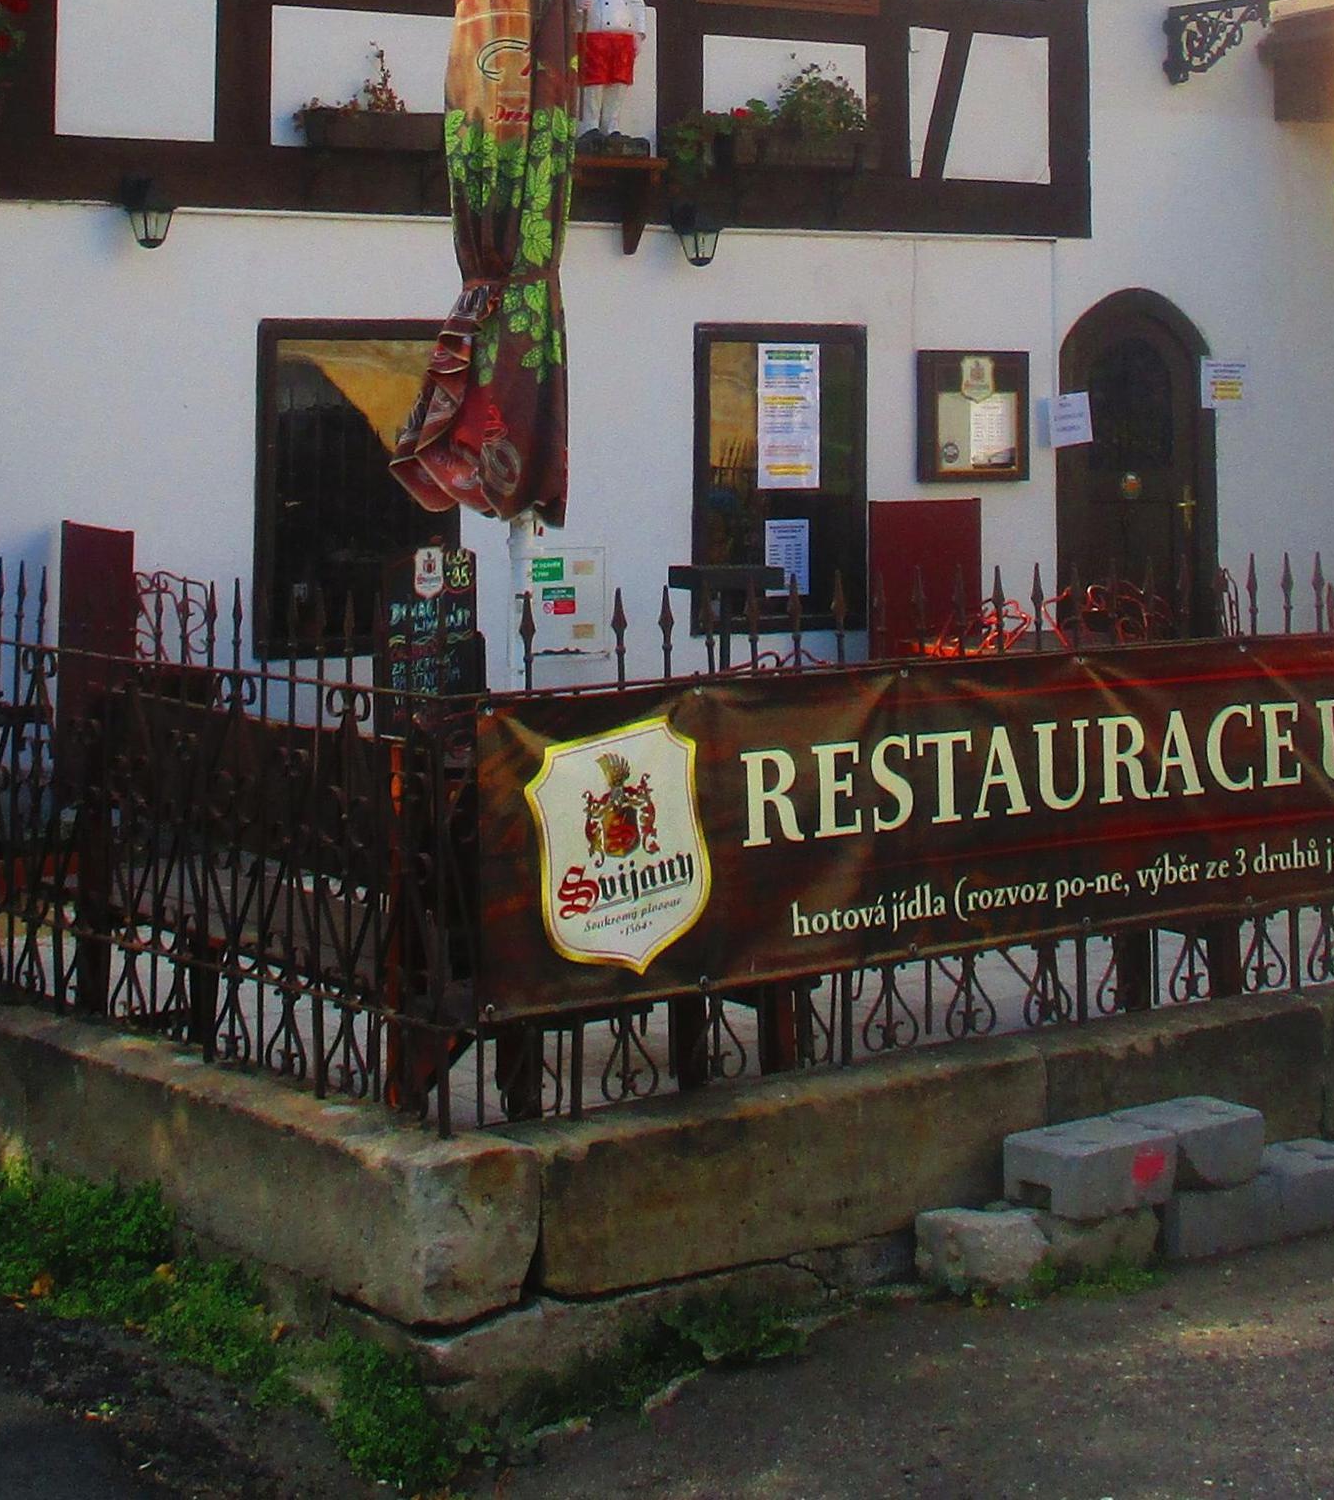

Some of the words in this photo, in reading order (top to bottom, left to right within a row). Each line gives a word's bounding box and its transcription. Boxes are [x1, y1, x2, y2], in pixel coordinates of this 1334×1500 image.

[740, 702, 1302, 848] RESTAURACE
[557, 851, 694, 920] Svijany
[791, 895, 886, 937] hotová
[892, 882, 947, 933] jídla
[954, 876, 1049, 922] (rozvoz
[1055, 871, 1130, 908] po-ne,
[1136, 852, 1200, 896] výběr
[1205, 859, 1230, 880] ze
[1235, 848, 1247, 877] 3
[1253, 838, 1321, 874] druhů
